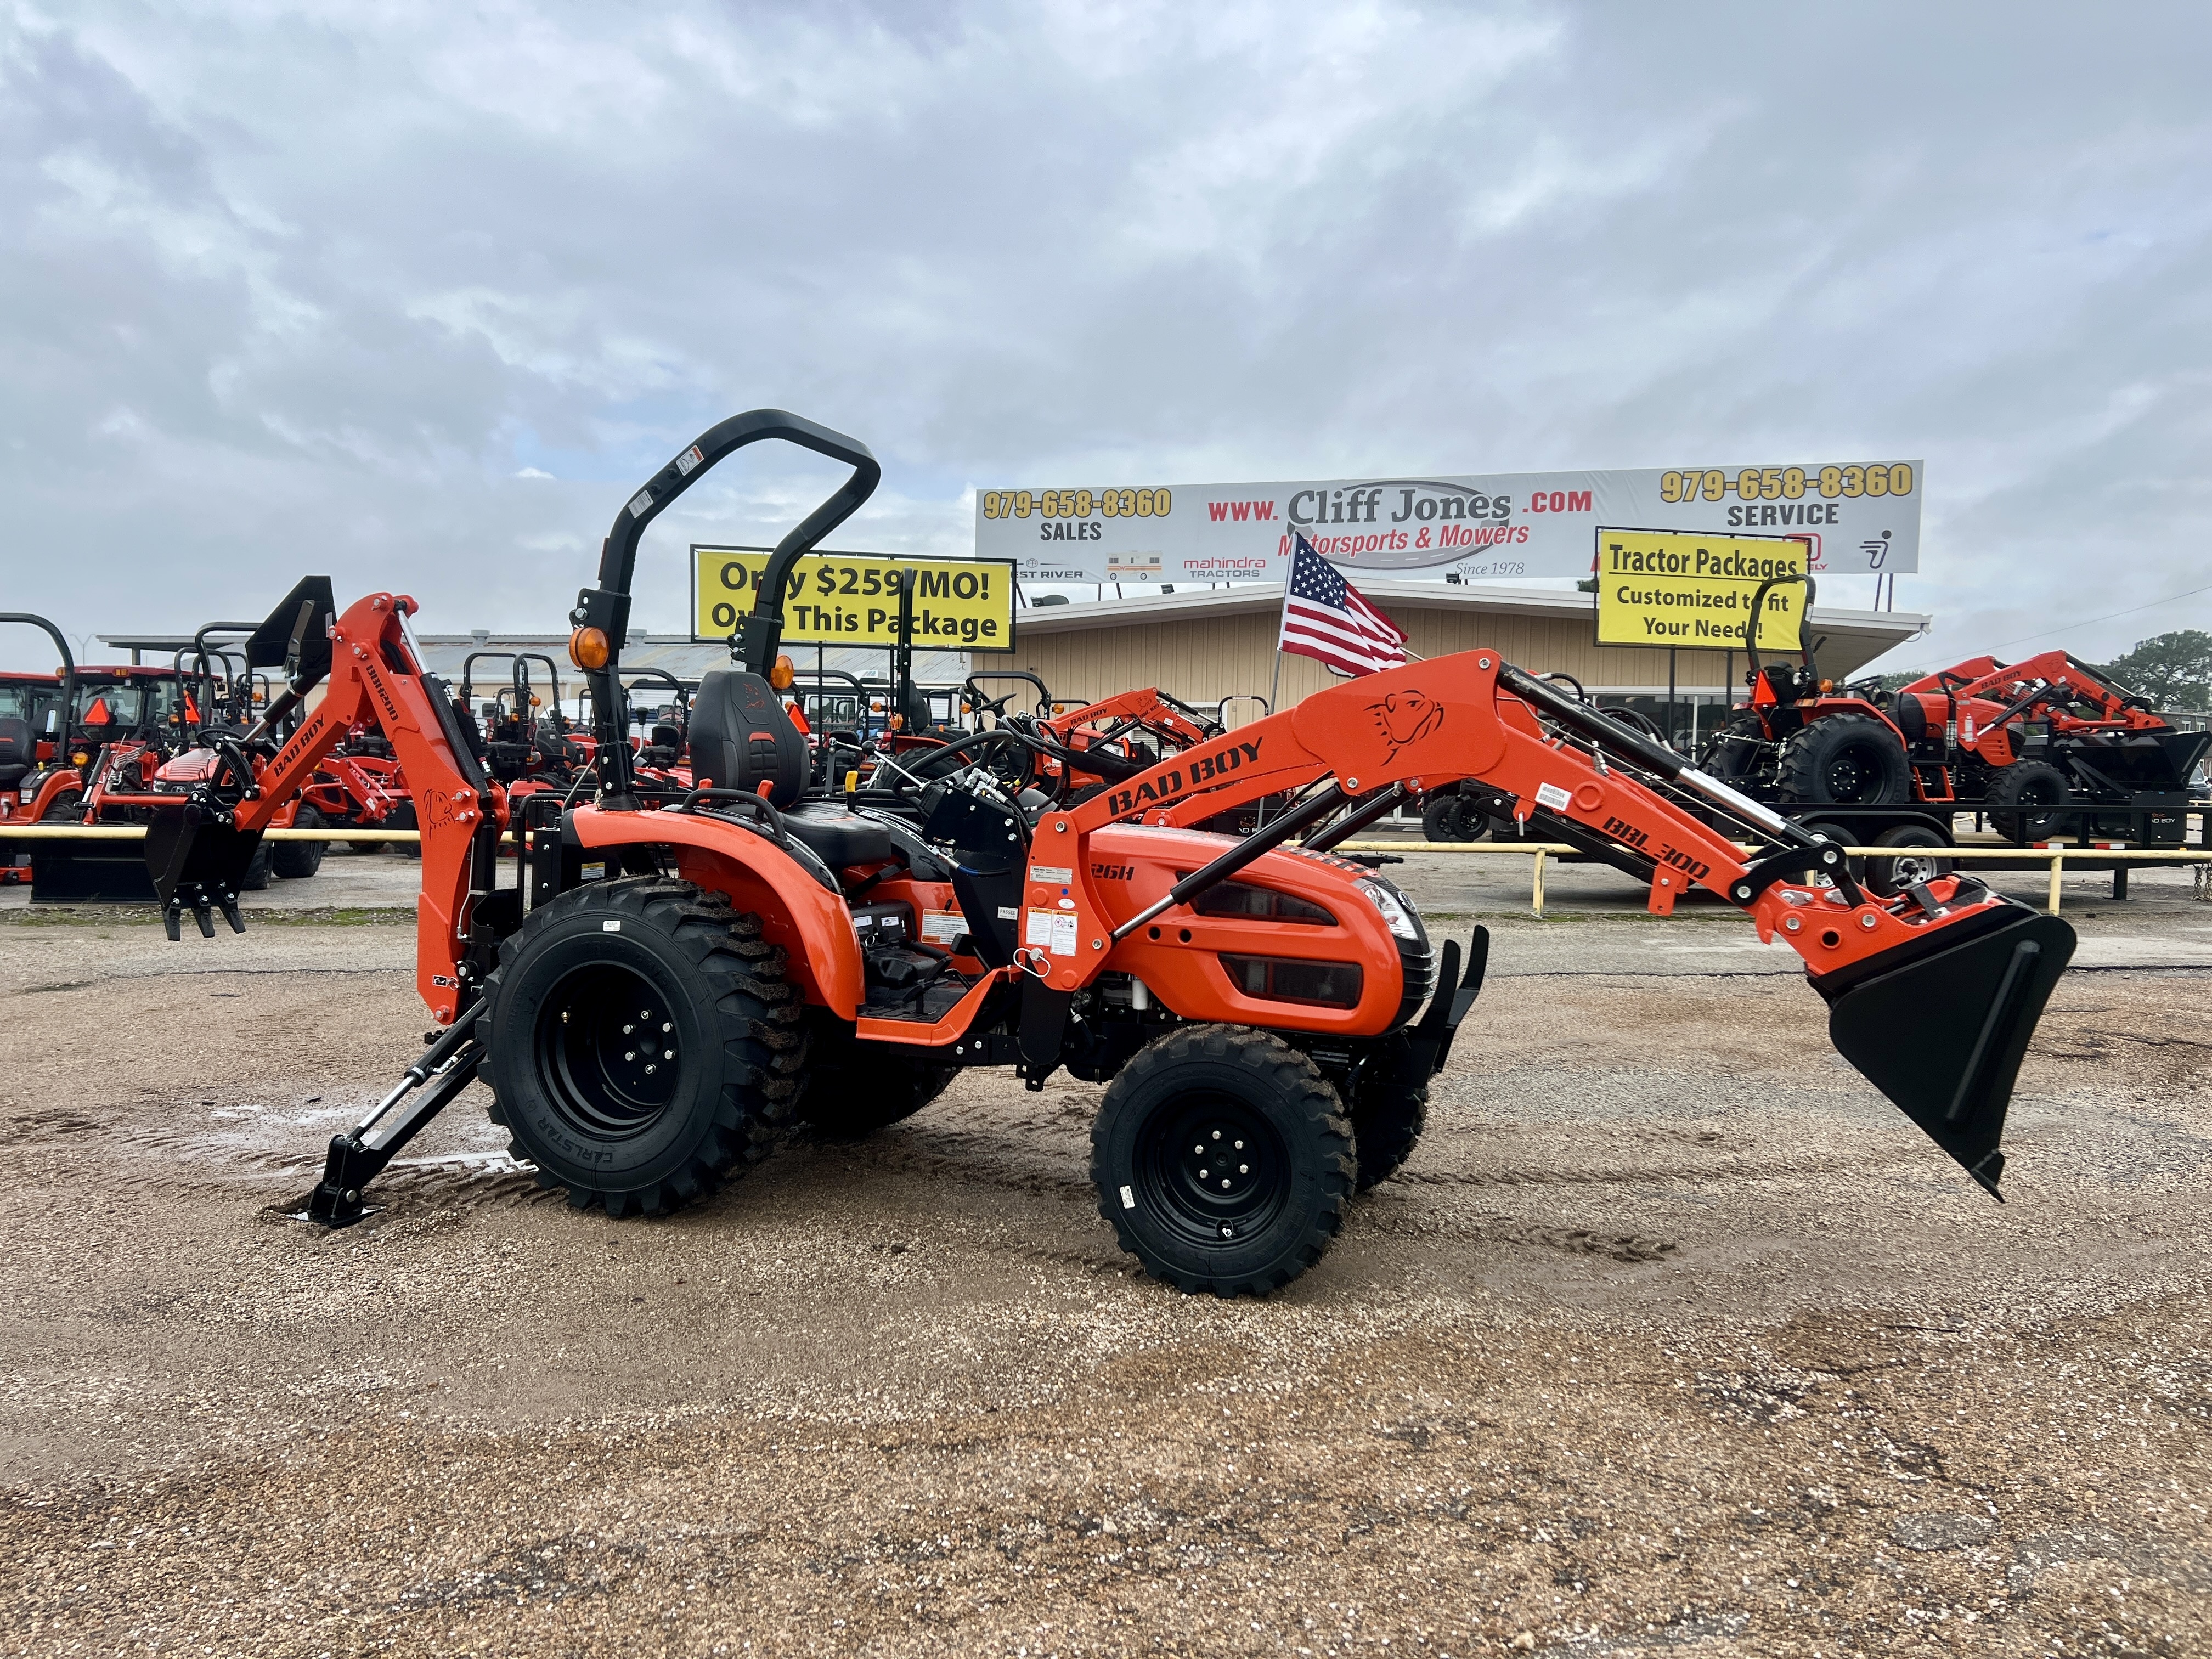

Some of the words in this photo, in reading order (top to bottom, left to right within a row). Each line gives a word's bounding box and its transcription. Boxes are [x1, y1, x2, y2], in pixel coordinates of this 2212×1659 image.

[1661, 463, 1913, 503] 979-658-8360
[983, 488, 1171, 520] 979-658-8360
[1288, 488, 1383, 524] Cliff
[1391, 489, 1511, 522] Jones
[1522, 490, 1592, 513] .COM
[1728, 504, 1839, 526] SERVICE
[1040, 522, 1102, 541] SALES
[1278, 528, 1408, 558] Mtorsports
[1415, 527, 1431, 549] &
[1439, 525, 1530, 548] Mowers
[1184, 557, 1266, 568] mahindra
[1189, 569, 1260, 578] TRACTORS
[1455, 562, 1487, 575] Since
[1491, 562, 1525, 574] 1978
[1610, 544, 1690, 573] Tractor
[1696, 549, 1797, 579] Packages
[720, 562, 807, 601] Ony
[1617, 586, 1737, 609] Customized
[1768, 593, 1789, 611] fit
[793, 605, 858, 633] This
[868, 608, 997, 643] Package
[1644, 617, 1690, 635] Your
[1695, 619, 1763, 640] Need!
[1982, 678, 2001, 689] BAD
[2004, 670, 2022, 681] BOY
[1070, 714, 1088, 725] BAD
[1090, 707, 1108, 719] BOY
[275, 744, 301, 777] BAD
[300, 714, 325, 751] BOY
[1108, 771, 1183, 817] BAD
[1190, 736, 1263, 785] BOY
[1602, 816, 1650, 851] BBL
[1654, 843, 1712, 879] 300
